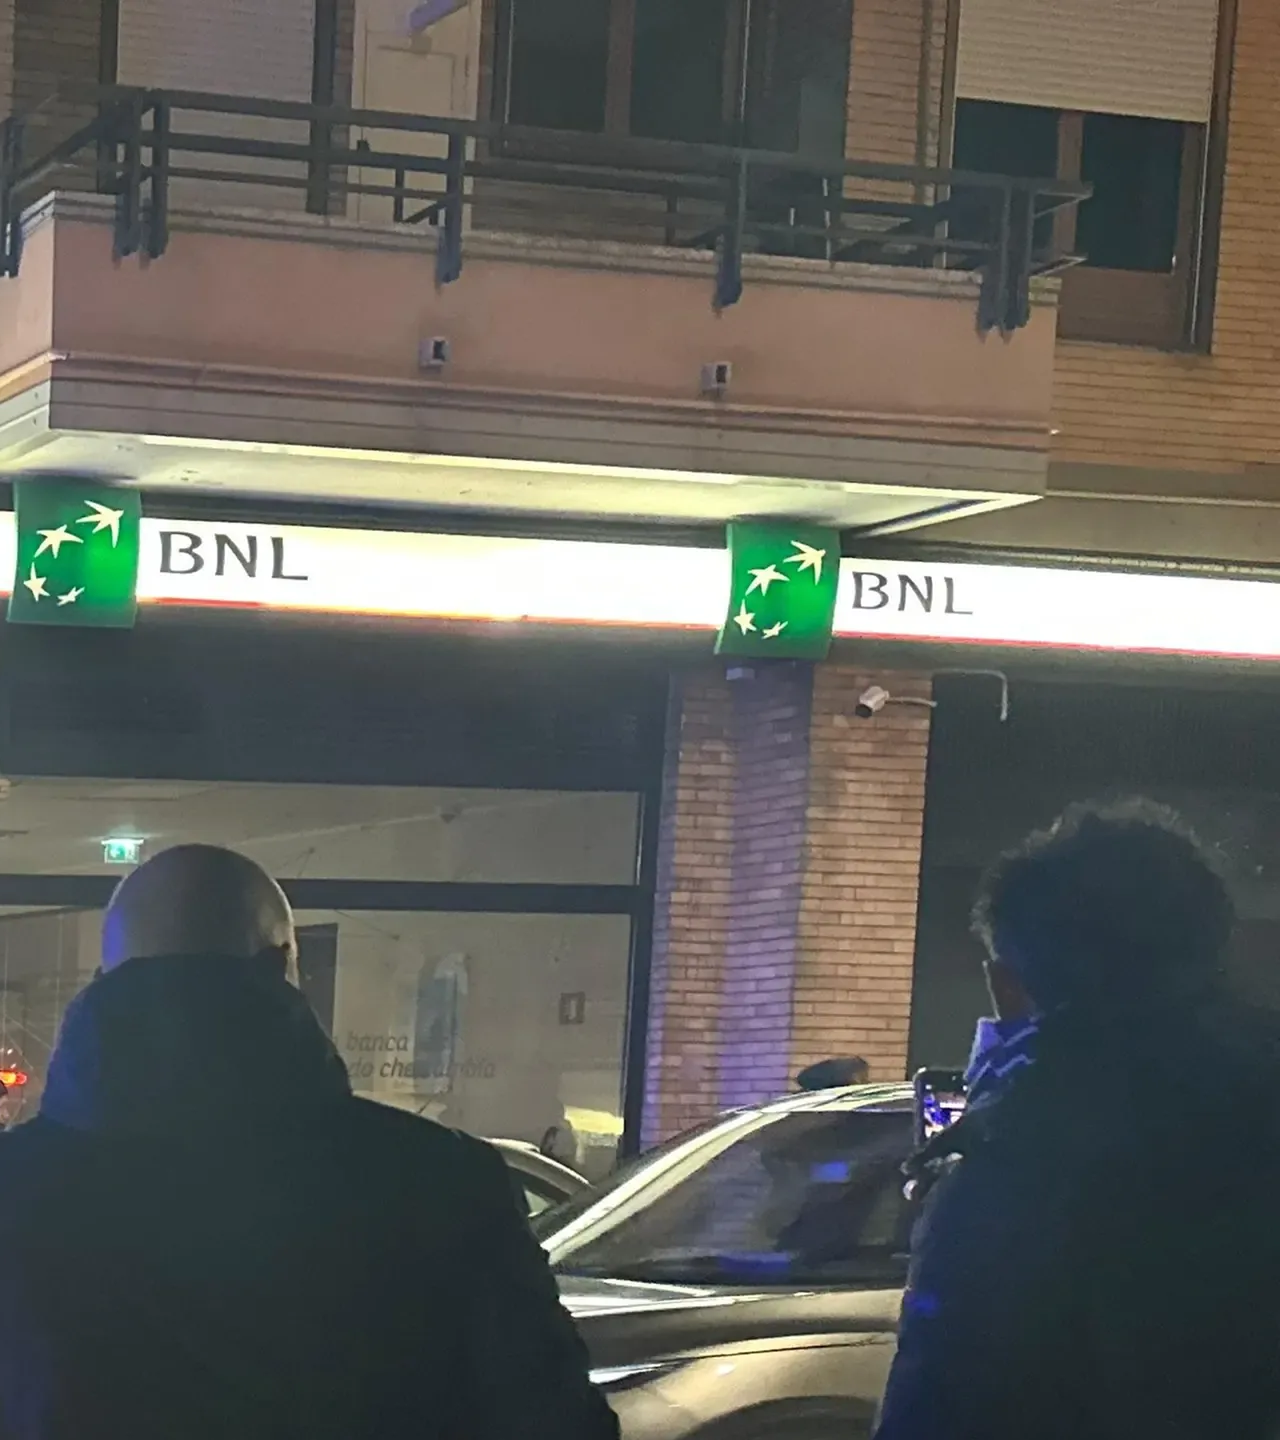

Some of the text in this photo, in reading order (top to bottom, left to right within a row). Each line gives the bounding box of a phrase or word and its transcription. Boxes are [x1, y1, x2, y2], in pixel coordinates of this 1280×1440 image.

[159, 530, 309, 581] BNL
[851, 570, 974, 616] BNL
[347, 1030, 408, 1052] banca
